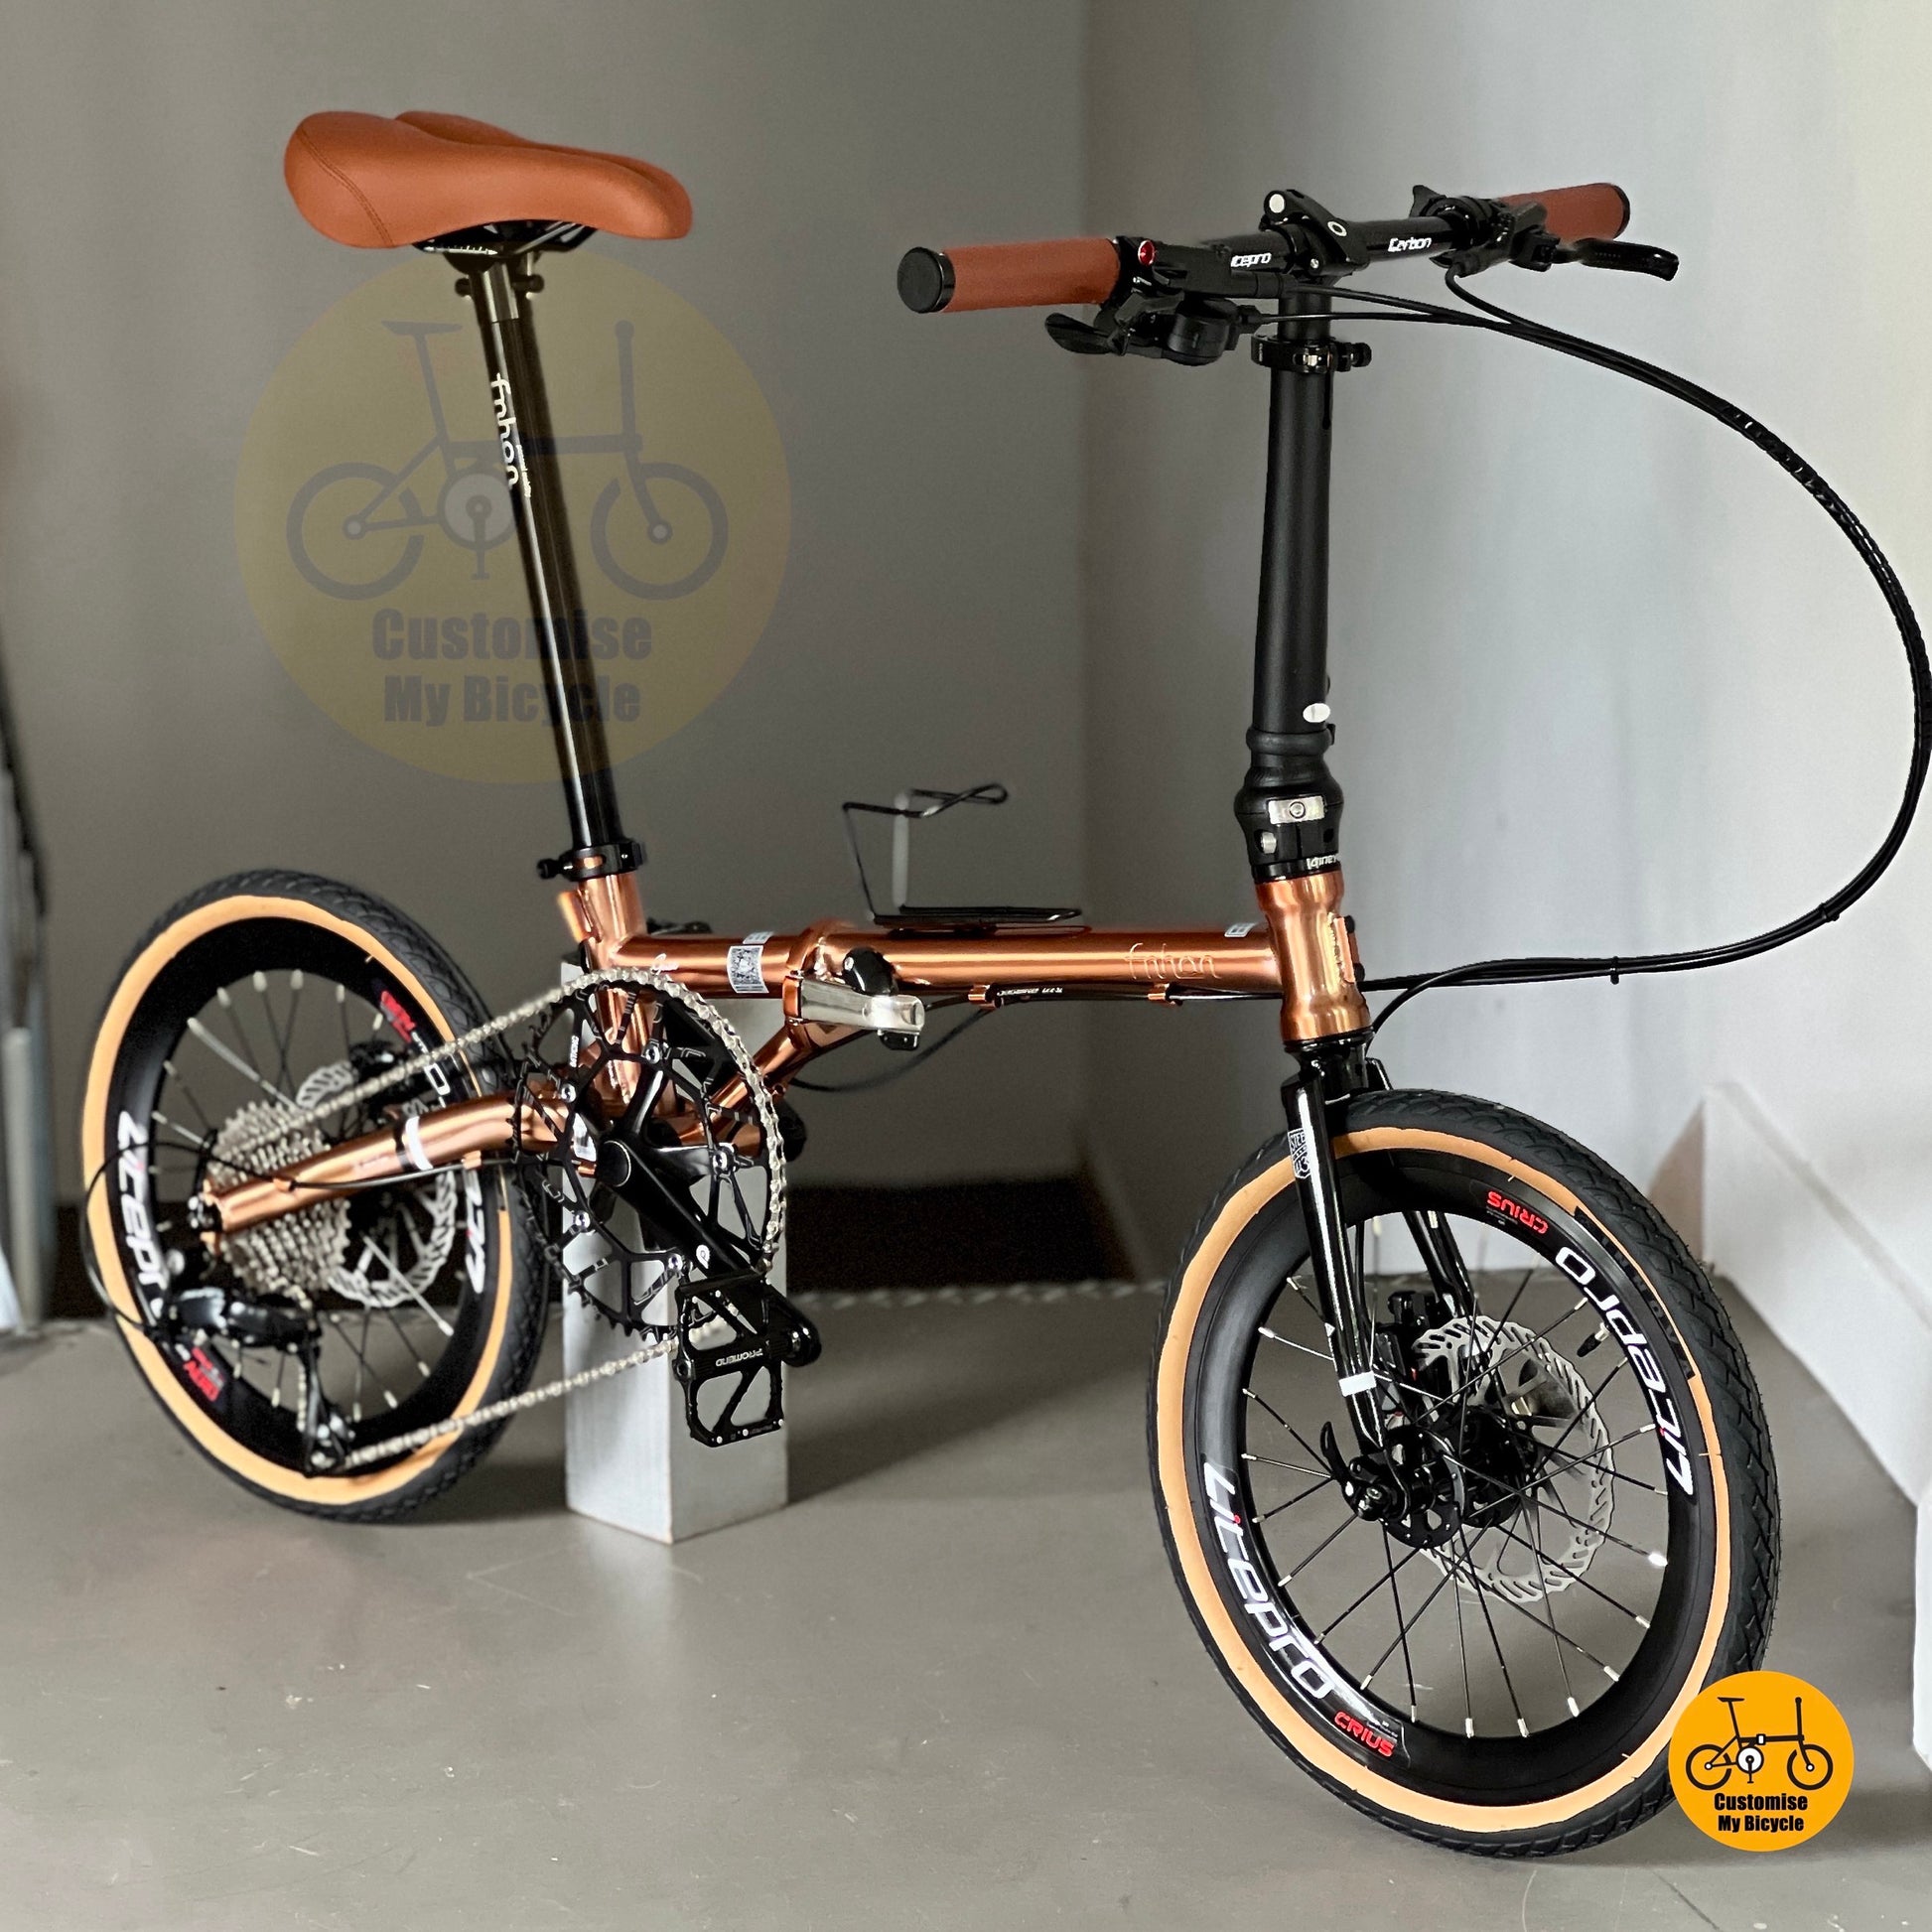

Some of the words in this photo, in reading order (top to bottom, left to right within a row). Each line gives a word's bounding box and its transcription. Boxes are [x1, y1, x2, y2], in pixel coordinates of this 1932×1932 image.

[1387, 235, 1432, 252] Carbon
[1486, 1190, 1549, 1234] CRIUS
[715, 1347, 763, 1367] PROMEND
[1333, 1711, 1395, 1757] CRIUS
